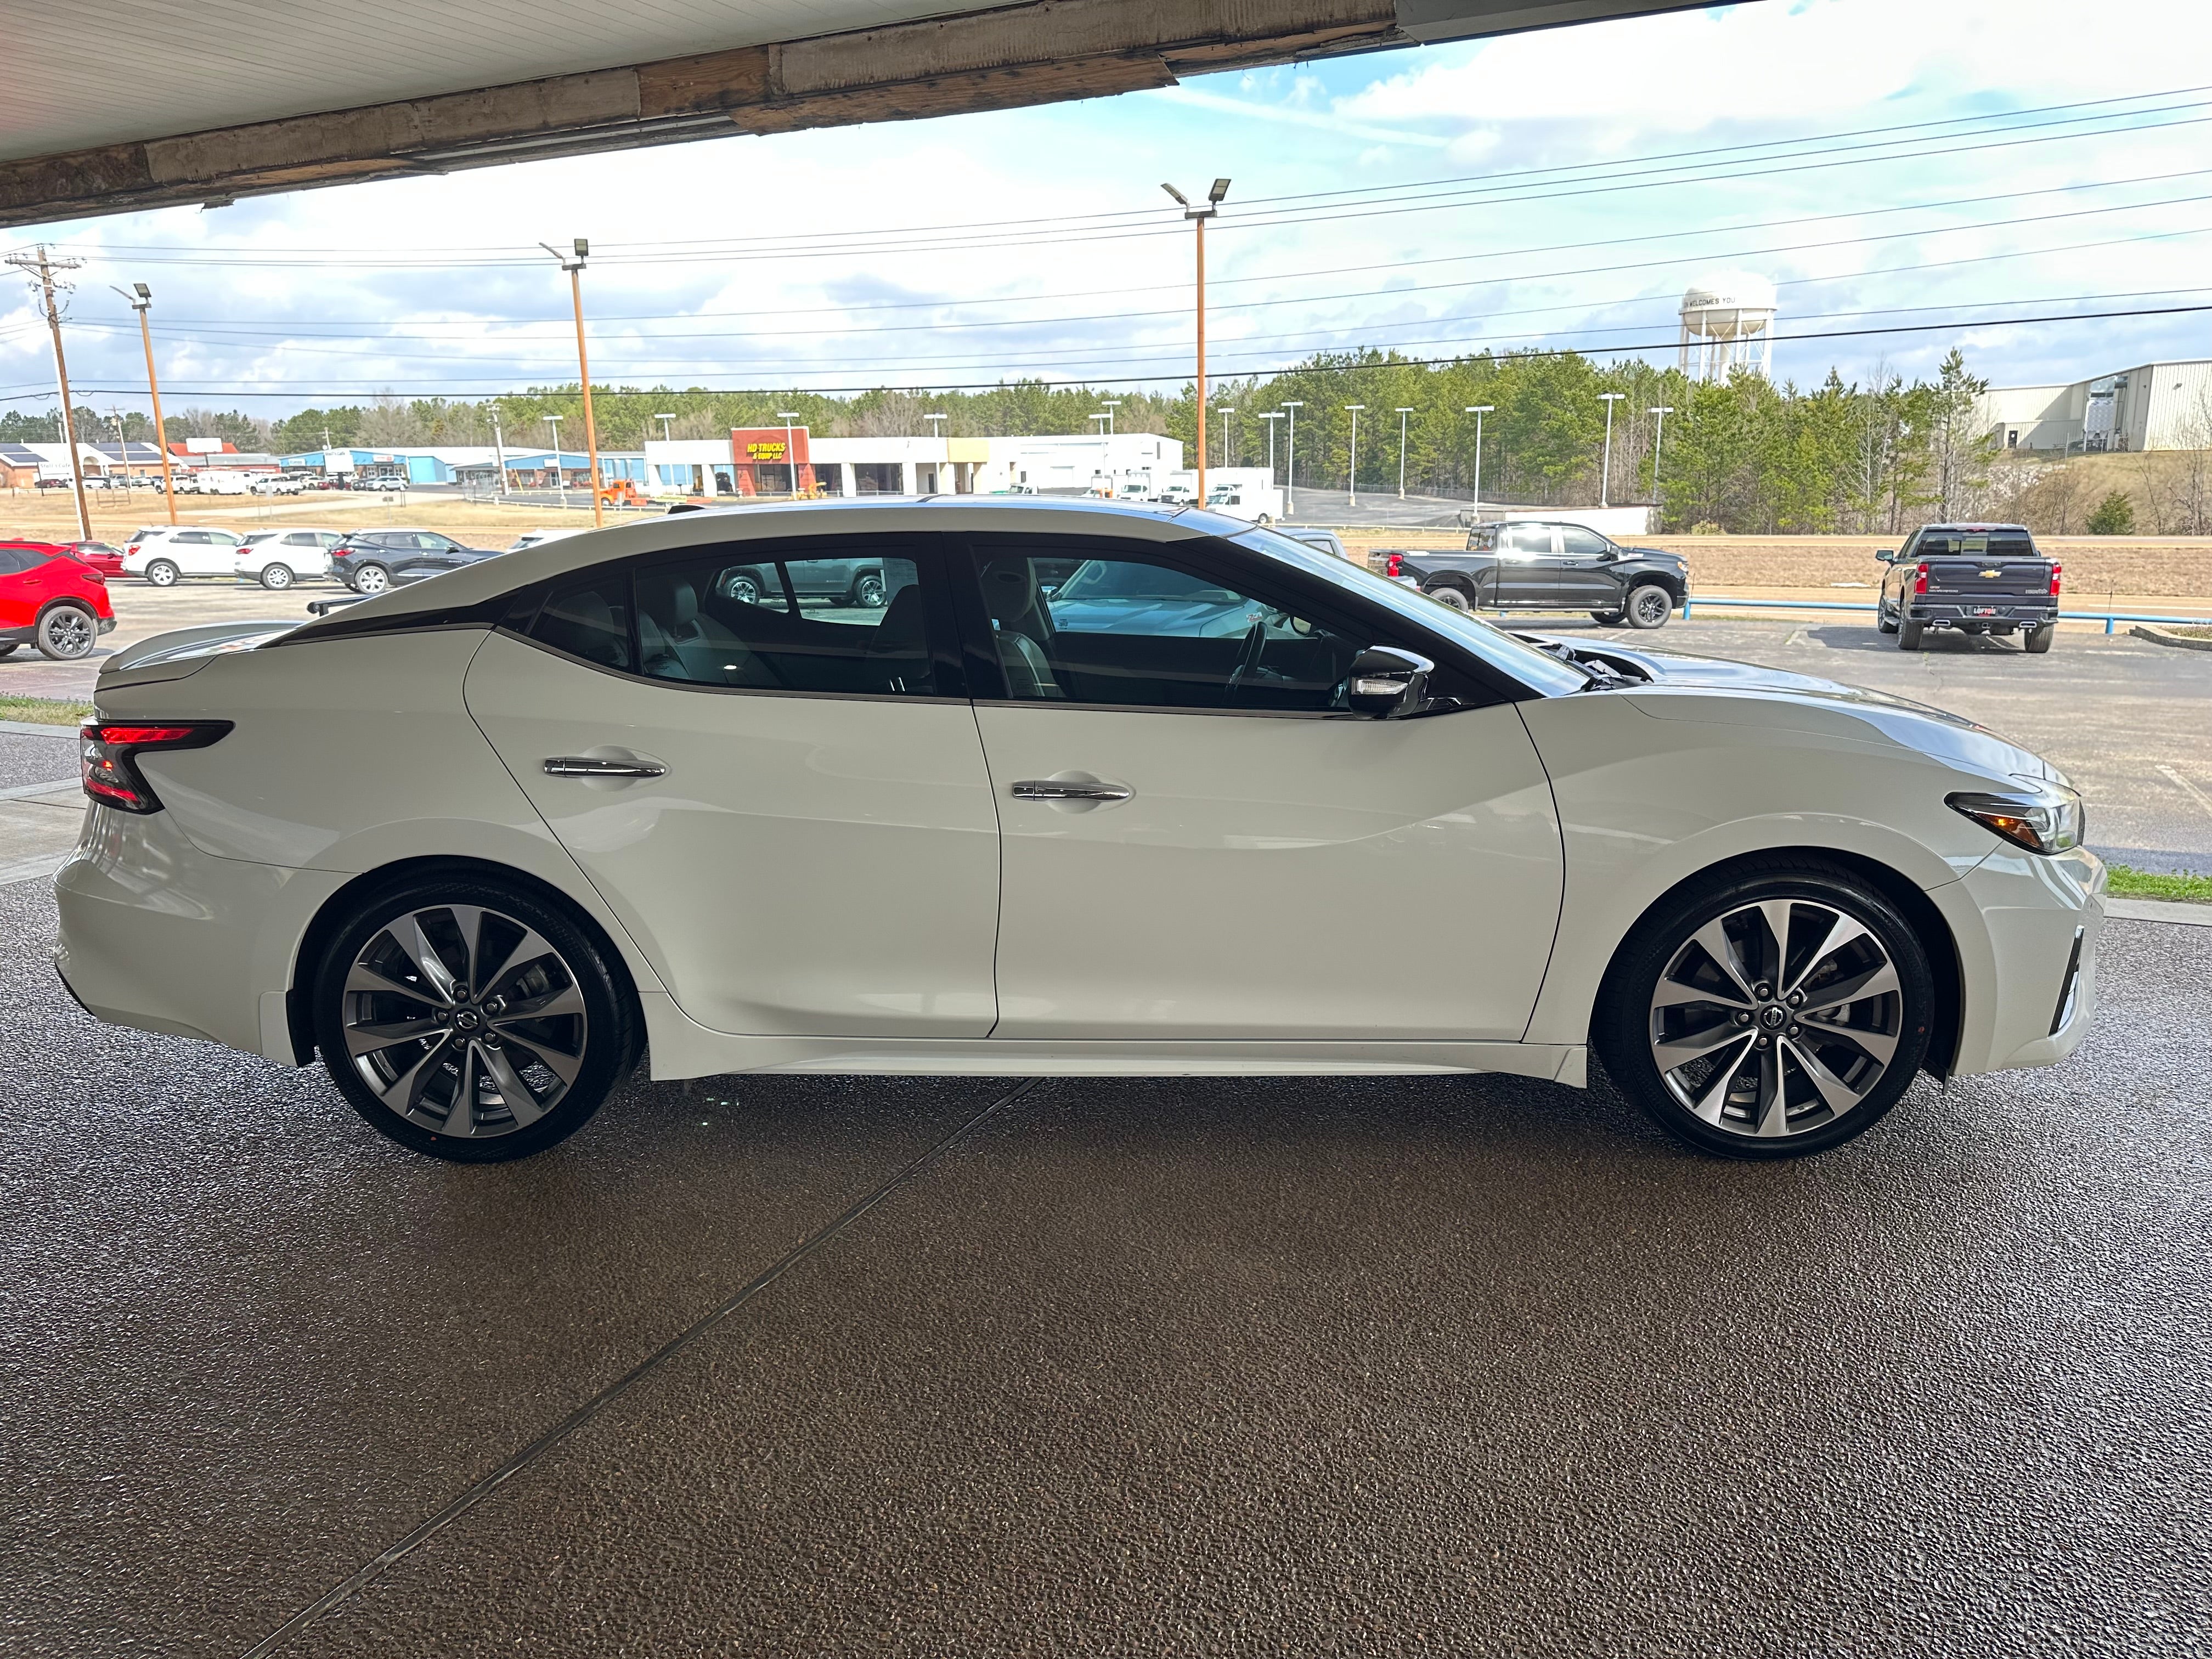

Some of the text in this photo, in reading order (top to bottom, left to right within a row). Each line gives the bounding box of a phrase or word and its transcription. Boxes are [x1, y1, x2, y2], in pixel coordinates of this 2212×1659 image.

[1690, 298, 1719, 307] WELCOMES
[747, 442, 786, 453] HD TRUCKS
